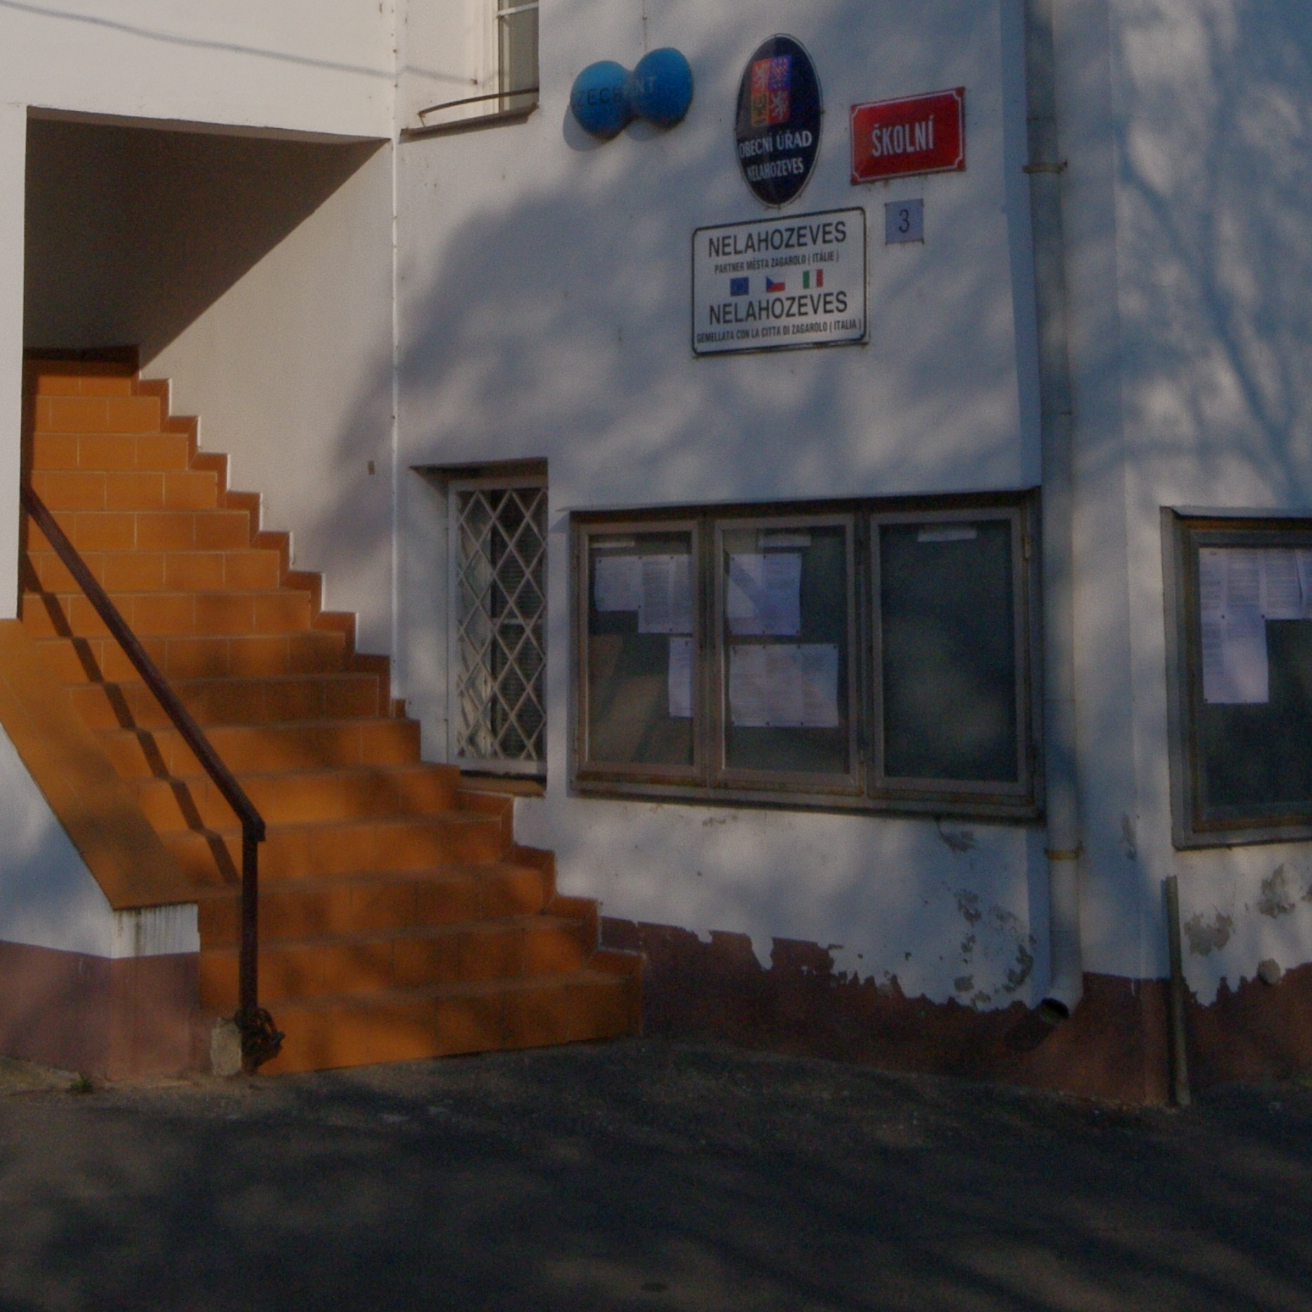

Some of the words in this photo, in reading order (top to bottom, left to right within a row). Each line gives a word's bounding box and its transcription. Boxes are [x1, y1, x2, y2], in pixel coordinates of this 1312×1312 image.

[739, 132, 773, 158] OBECNÍ
[776, 129, 812, 150] ÚŘAD
[871, 114, 935, 158] ŠKOLNÍ
[746, 157, 804, 182] NELAHOZEVES
[898, 209, 910, 234] 3
[708, 221, 848, 258] NELAHOZEVES
[714, 261, 745, 274] PARTNER
[771, 254, 806, 268] ZAGAROLO
[709, 290, 848, 325] NELAHOZEVES
[697, 330, 734, 344] GEMELLATA
[736, 328, 750, 340] CON
[751, 328, 760, 338] LA
[782, 325, 790, 336] DI
[792, 321, 828, 335] ZAGAROLO
